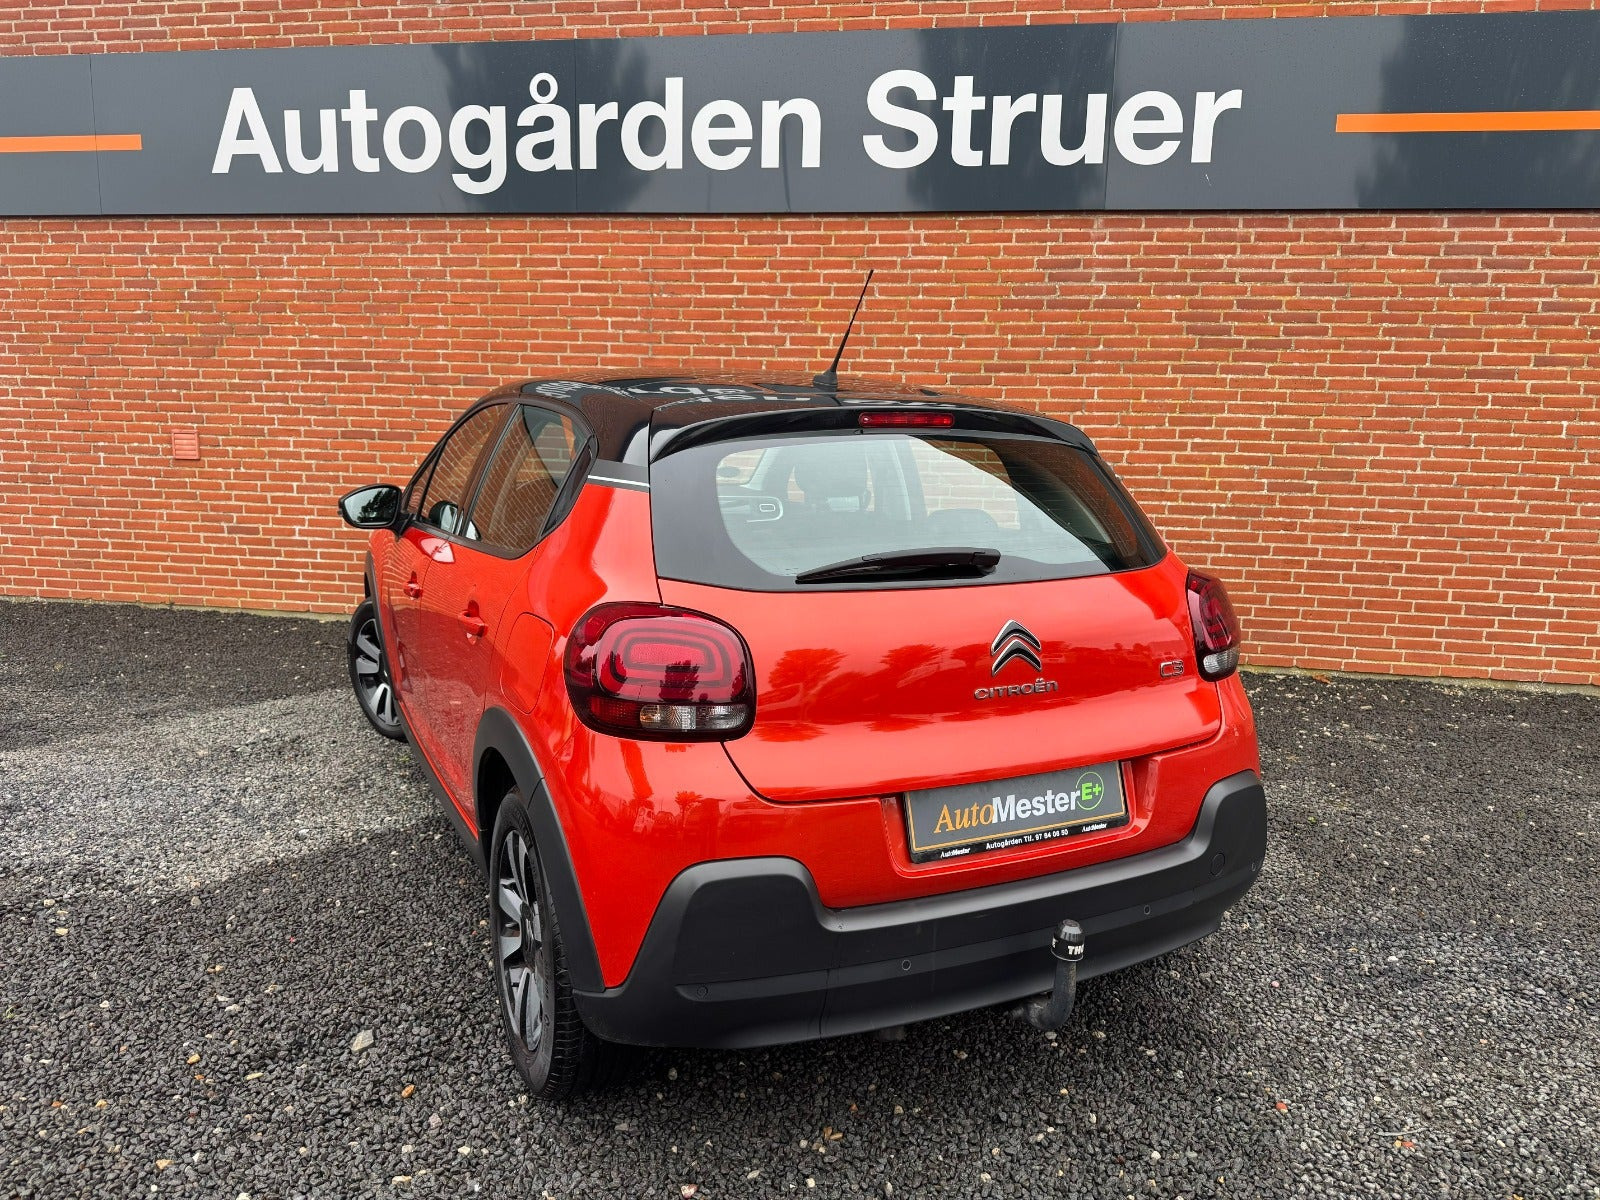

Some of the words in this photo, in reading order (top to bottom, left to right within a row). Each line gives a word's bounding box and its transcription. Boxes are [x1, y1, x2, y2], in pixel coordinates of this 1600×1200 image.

[212, 73, 822, 195] Autogården
[863, 69, 1243, 169] Struer
[1160, 660, 1184, 677] C3
[974, 678, 1059, 699] CITROËN
[933, 788, 1081, 834] AutoMester
[986, 837, 1023, 850] Autogården
